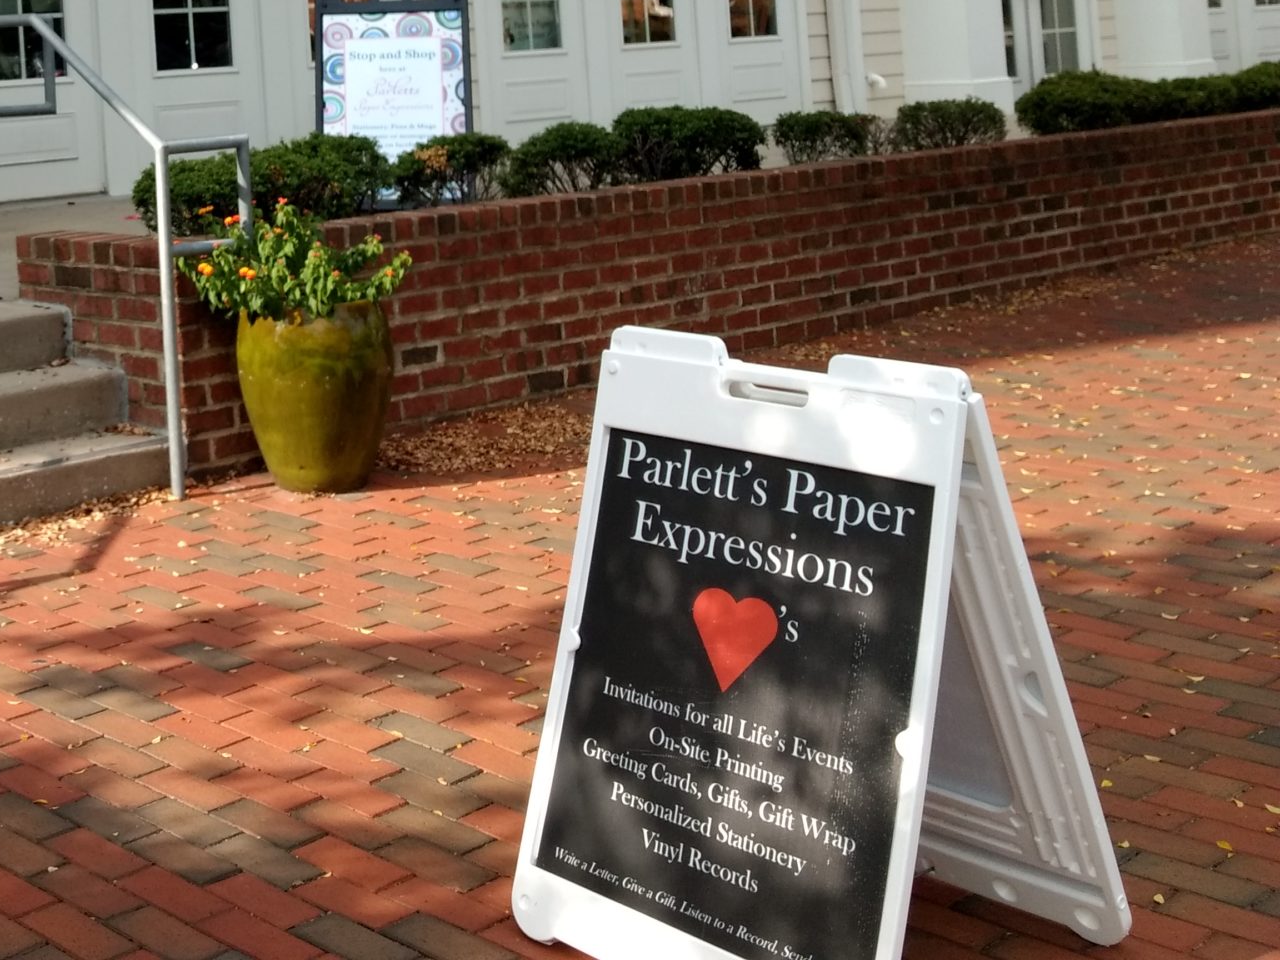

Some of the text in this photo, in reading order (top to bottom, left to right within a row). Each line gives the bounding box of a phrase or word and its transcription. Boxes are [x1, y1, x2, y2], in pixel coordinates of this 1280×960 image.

[349, 47, 436, 63] Stop and Shop
[617, 437, 915, 537] Parlett's Paper
[630, 499, 874, 597] Expressions
[779, 605, 800, 643] 's
[603, 676, 854, 775] Invitations for all Life's Events
[649, 726, 785, 793] On-Site Printing
[583, 737, 857, 857] Greeting Cards, Gifts, Gift Wrap
[610, 781, 808, 877] Personalized Stationery
[554, 846, 581, 868] Write
[581, 861, 588, 871] a
[588, 862, 621, 886] Letter,
[622, 876, 646, 897] Give
[646, 888, 654, 899] a
[655, 890, 677, 910] Gift,
[679, 900, 713, 925] Listen
[713, 917, 726, 929] to
[726, 924, 734, 935] a
[735, 925, 779, 955] Record,
[641, 828, 759, 893] Vinyl Records
